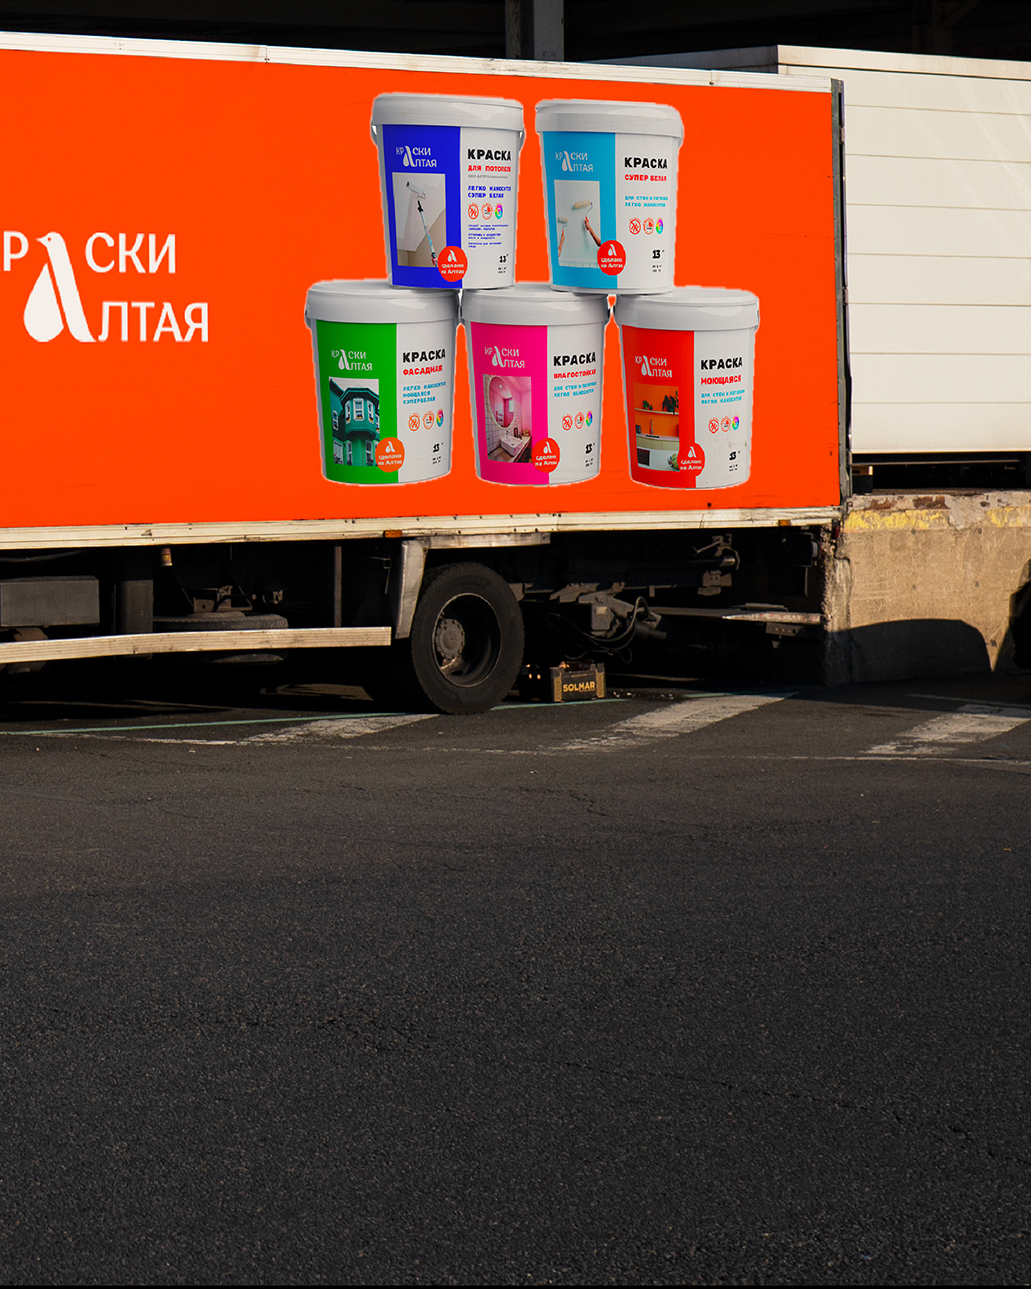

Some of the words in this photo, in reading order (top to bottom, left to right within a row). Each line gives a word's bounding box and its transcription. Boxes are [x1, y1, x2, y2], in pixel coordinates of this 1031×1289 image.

[468, 149, 511, 161] КРАСКА
[624, 157, 667, 169] КРАСКА
[403, 348, 445, 362] КРАСКА
[554, 352, 596, 366] КРАСКА
[700, 356, 742, 370] КРАСКА
[403, 364, 442, 375] ФАСАДНАЯ
[700, 374, 741, 385] МОЮЩАЯСЯ
[562, 681, 596, 692] SOLMAR
